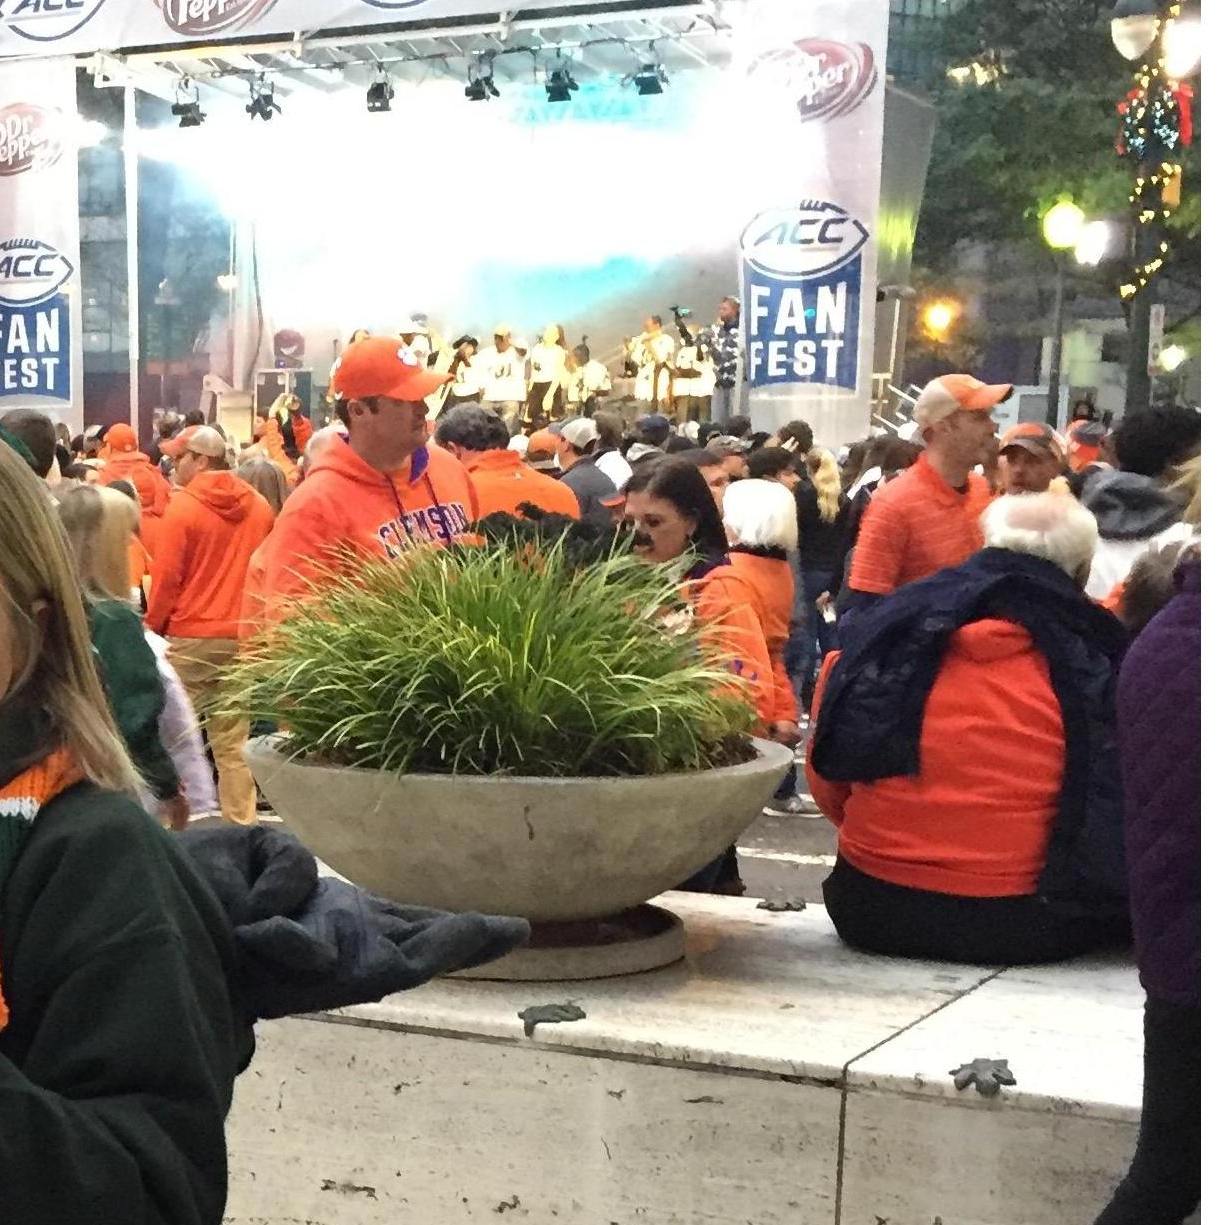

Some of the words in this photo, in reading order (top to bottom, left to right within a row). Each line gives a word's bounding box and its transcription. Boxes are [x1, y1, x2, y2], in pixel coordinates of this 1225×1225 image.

[5, 113, 33, 140] Dr
[754, 218, 849, 247] ACC
[750, 281, 847, 336] FAN
[750, 339, 844, 381] FEST
